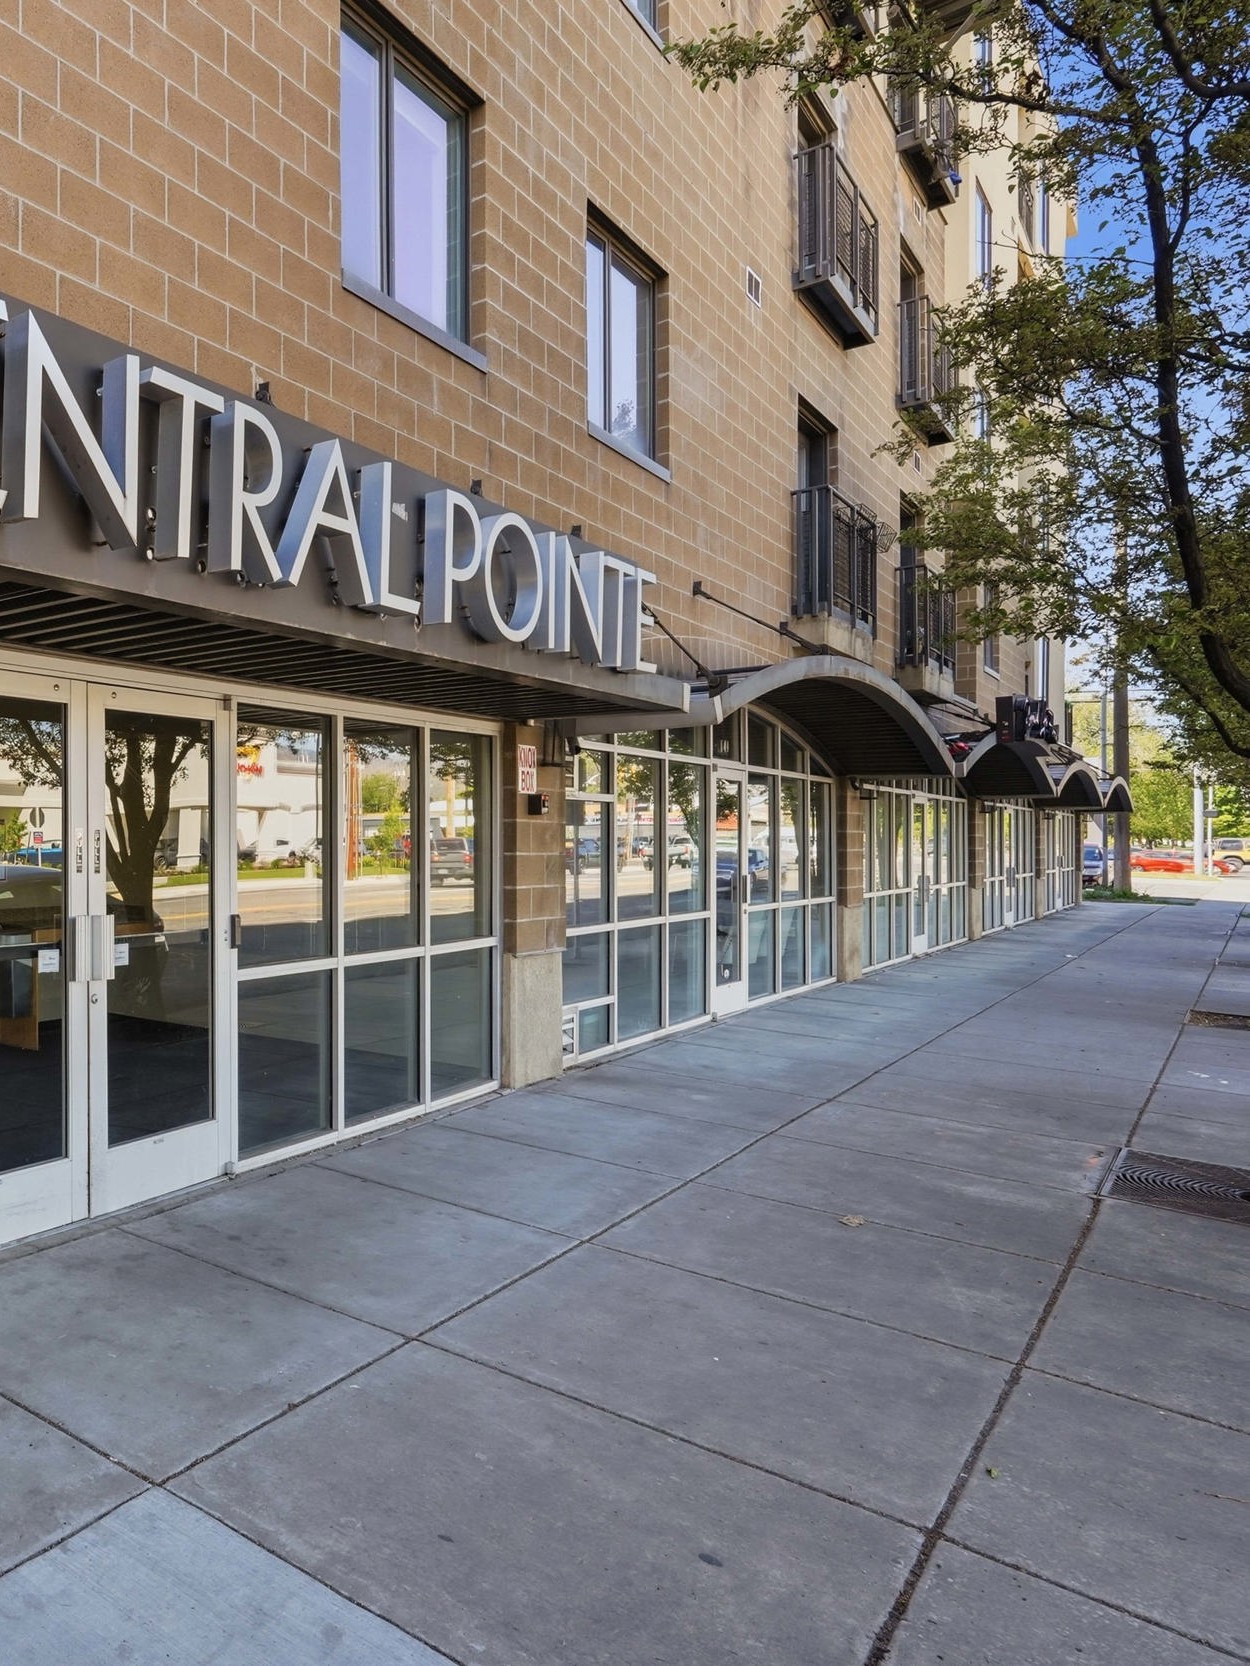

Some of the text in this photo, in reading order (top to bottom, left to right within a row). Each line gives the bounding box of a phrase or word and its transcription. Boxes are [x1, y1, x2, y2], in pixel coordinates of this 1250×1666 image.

[424, 488, 657, 674] POINTE
[518, 747, 535, 768] KNOX
[521, 770, 535, 791] BOX
